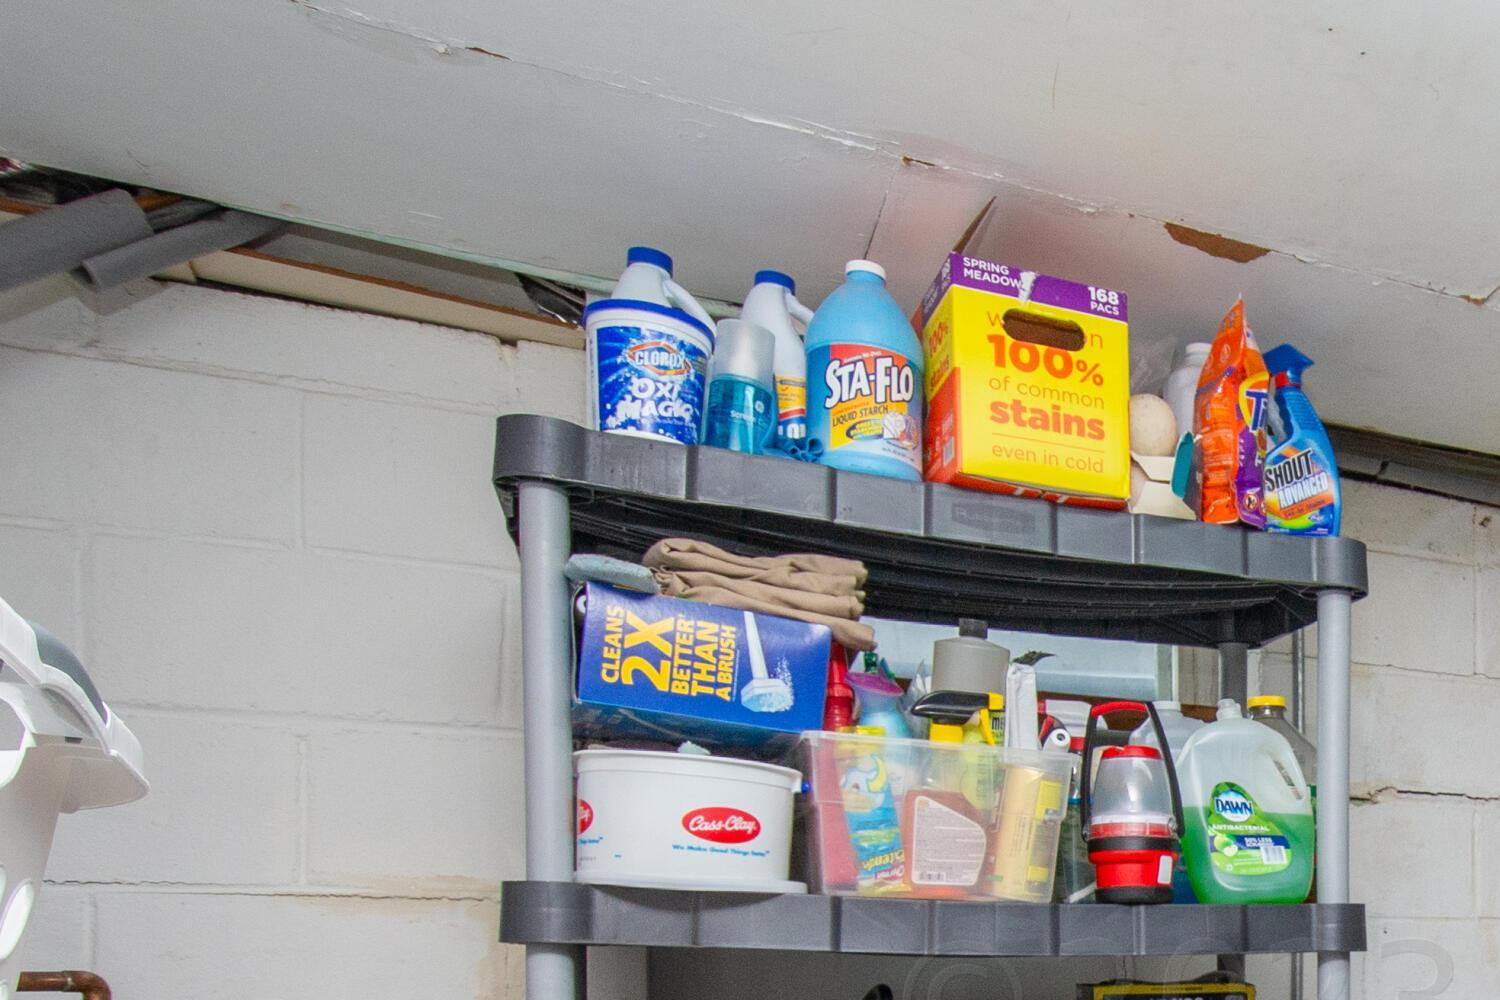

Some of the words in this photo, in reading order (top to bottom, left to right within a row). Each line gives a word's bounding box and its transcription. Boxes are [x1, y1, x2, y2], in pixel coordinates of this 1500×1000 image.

[962, 256, 1010, 275] SPRING
[962, 268, 1023, 289] MEADOW
[1087, 285, 1119, 306] 168
[1089, 300, 1120, 317] PACS
[634, 350, 686, 369] CLOROX
[986, 333, 1104, 388] 100%
[630, 377, 680, 401] OXI
[825, 355, 914, 409] STA-FLO
[988, 375, 1013, 394] of
[1017, 383, 1105, 410] common
[832, 410, 858, 428] LIQUID
[859, 404, 890, 419] STARCH
[989, 398, 1106, 442] stains
[991, 444, 1039, 463] even
[1043, 447, 1060, 464] in
[1064, 450, 1105, 474] cold
[1264, 449, 1313, 493] SHOUT
[1278, 472, 1329, 510] ADVANCED
[601, 604, 625, 684] CLEANS
[620, 610, 675, 693] 2X
[690, 619, 722, 697] THAN
[716, 624, 737, 684] BRUSH
[714, 687, 731, 702] A
[1214, 798, 1255, 816] DAWN
[688, 815, 757, 835] Cass-Clay
